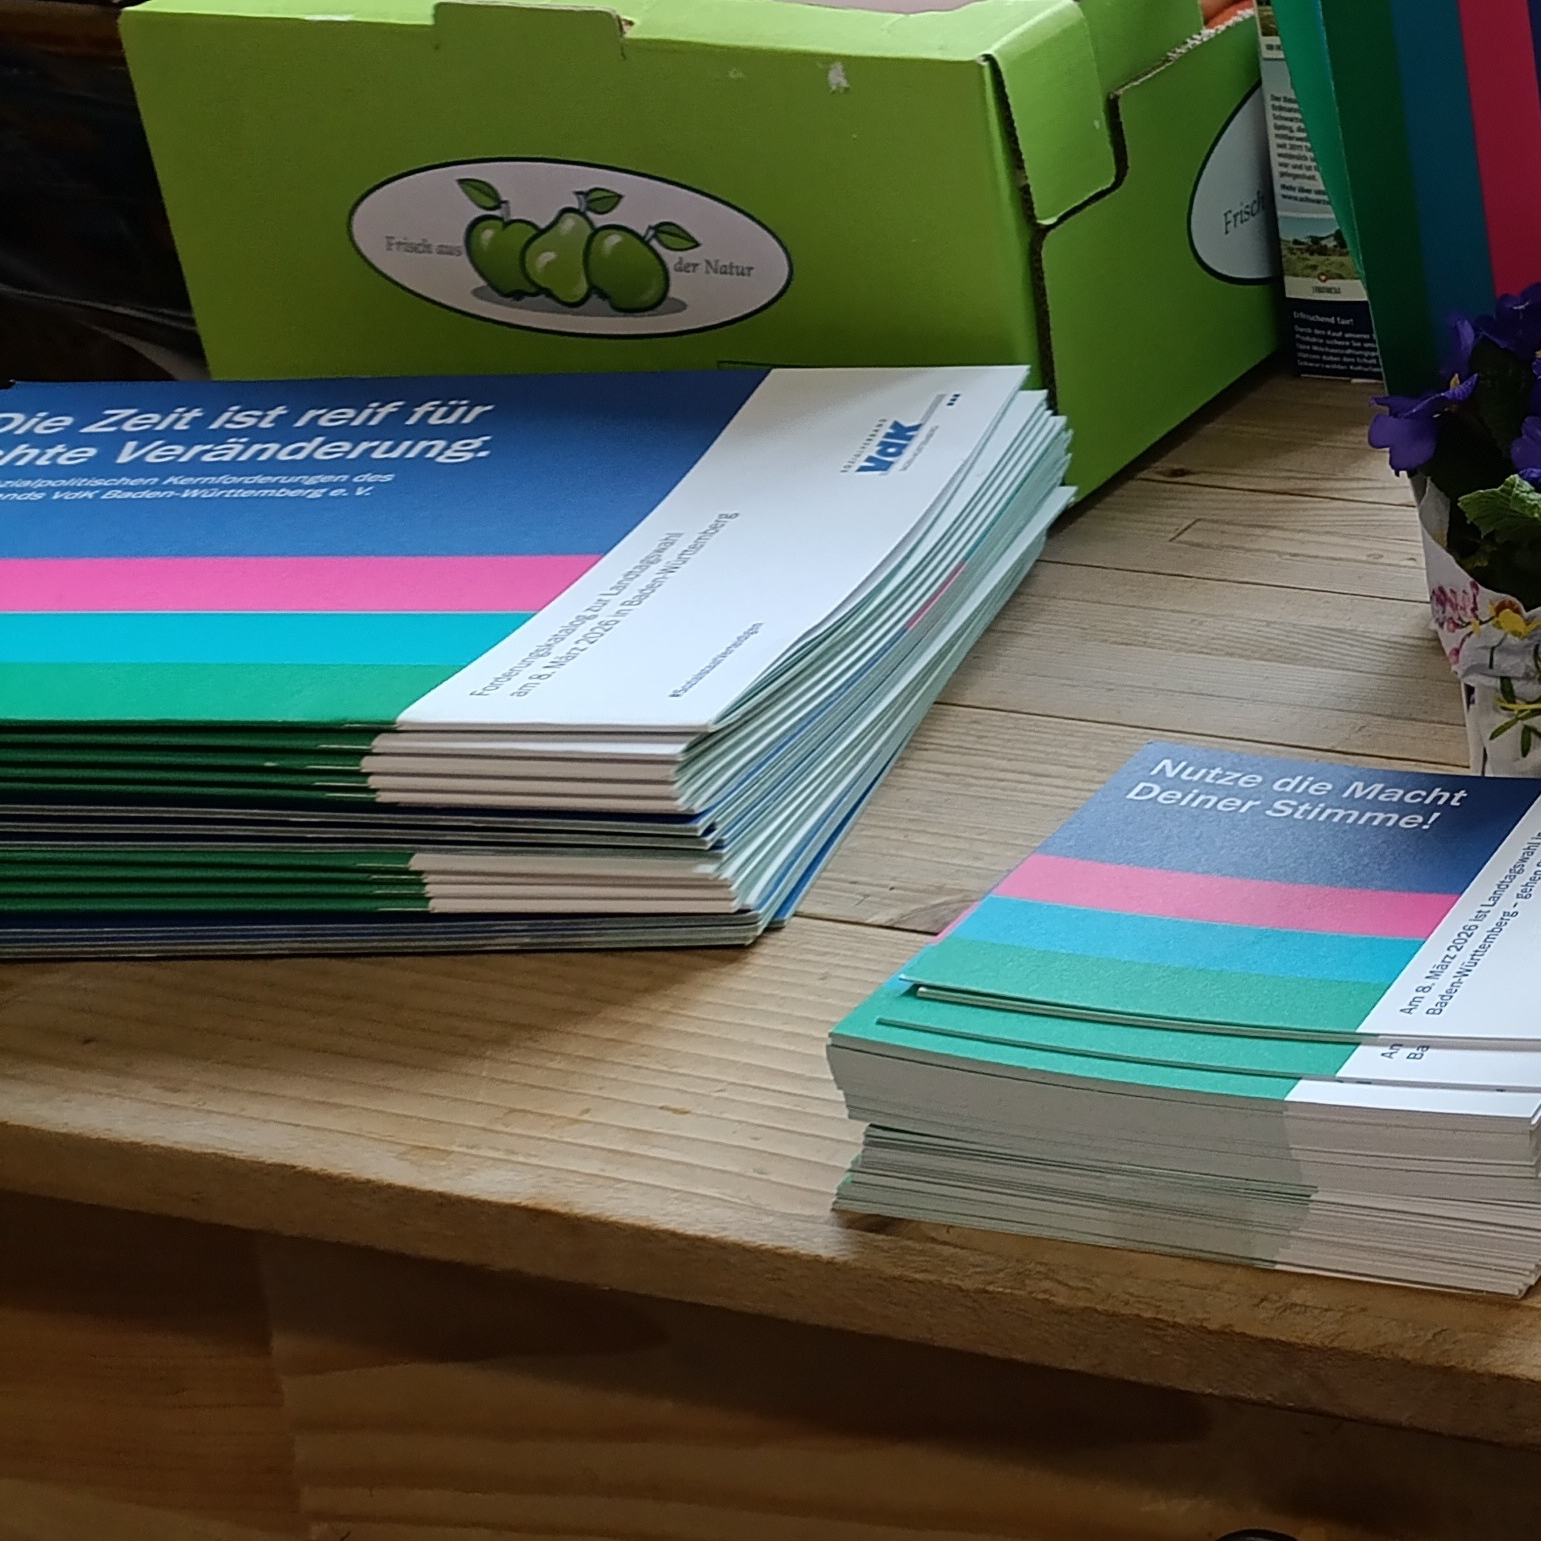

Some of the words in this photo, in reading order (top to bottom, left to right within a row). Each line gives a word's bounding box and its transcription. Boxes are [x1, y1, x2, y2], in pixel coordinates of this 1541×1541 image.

[673, 257, 700, 274] der
[704, 259, 755, 279] Natur
[0, 411, 74, 435] Die
[80, 406, 203, 435] Zeit
[208, 404, 288, 431] ist
[293, 400, 407, 428] reif
[403, 399, 495, 426] für
[114, 435, 494, 464] Veränderung.
[855, 420, 923, 472] VdK
[51, 489, 100, 500] VdK
[100, 484, 329, 500] Baden-Württemberg
[166, 472, 350, 485] Kernforderungen
[351, 472, 396, 483] des
[470, 609, 598, 697] Forderungskatalog
[604, 531, 686, 597] Landtagswahl
[543, 640, 590, 673] März
[577, 616, 621, 647] 2026
[622, 511, 740, 608] Baden-Württemberg
[1126, 781, 1261, 814] Deiner
[1264, 799, 1441, 831] Stimme!
[1149, 758, 1264, 789] Nutze
[1272, 775, 1334, 797] die
[1342, 781, 1469, 807] Macht
[1400, 992, 1424, 1015] Am
[1425, 952, 1456, 982] März
[1447, 924, 1479, 955] 2026
[1469, 908, 1491, 923] ist
[1426, 910, 1519, 1016] Baden-Württemberg
